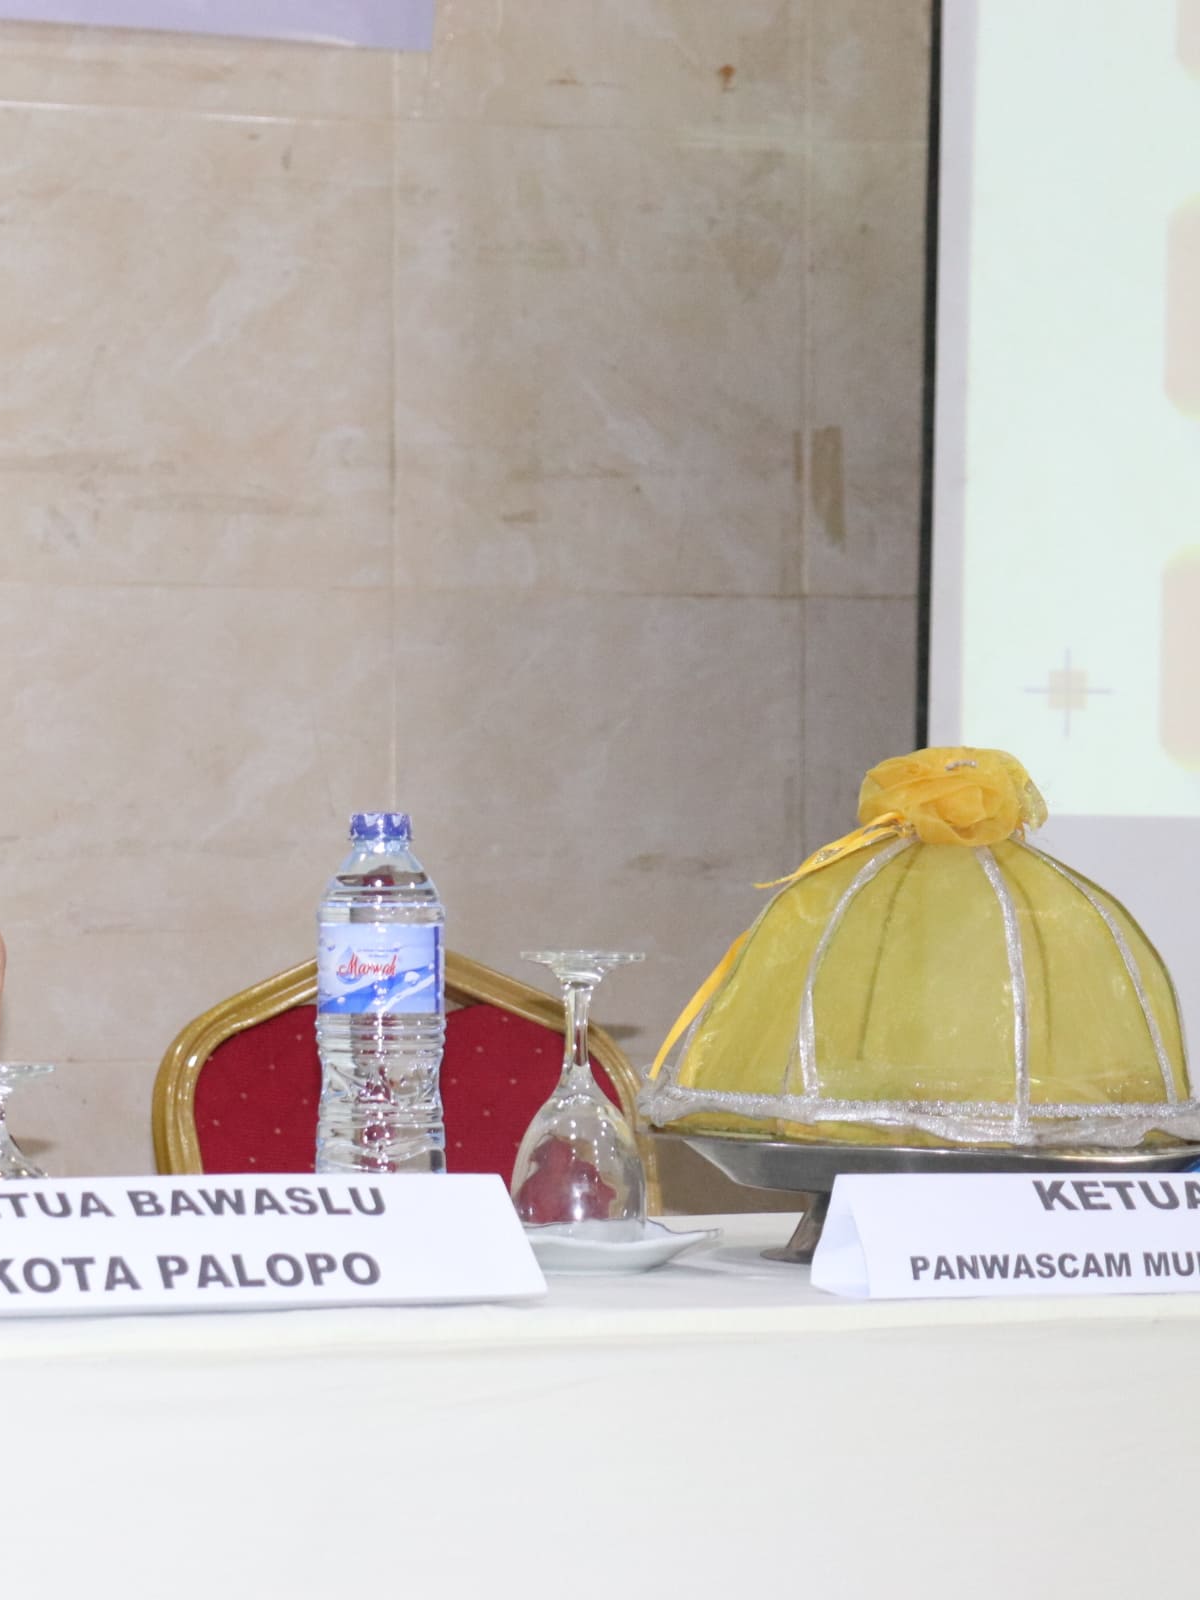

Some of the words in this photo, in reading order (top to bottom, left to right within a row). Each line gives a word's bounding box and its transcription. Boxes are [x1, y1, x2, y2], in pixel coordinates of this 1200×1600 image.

[127, 1186, 386, 1217] BAWASLU
[156, 1252, 381, 1289] PALOPO
[910, 1252, 1133, 1281] PANWASCAM
